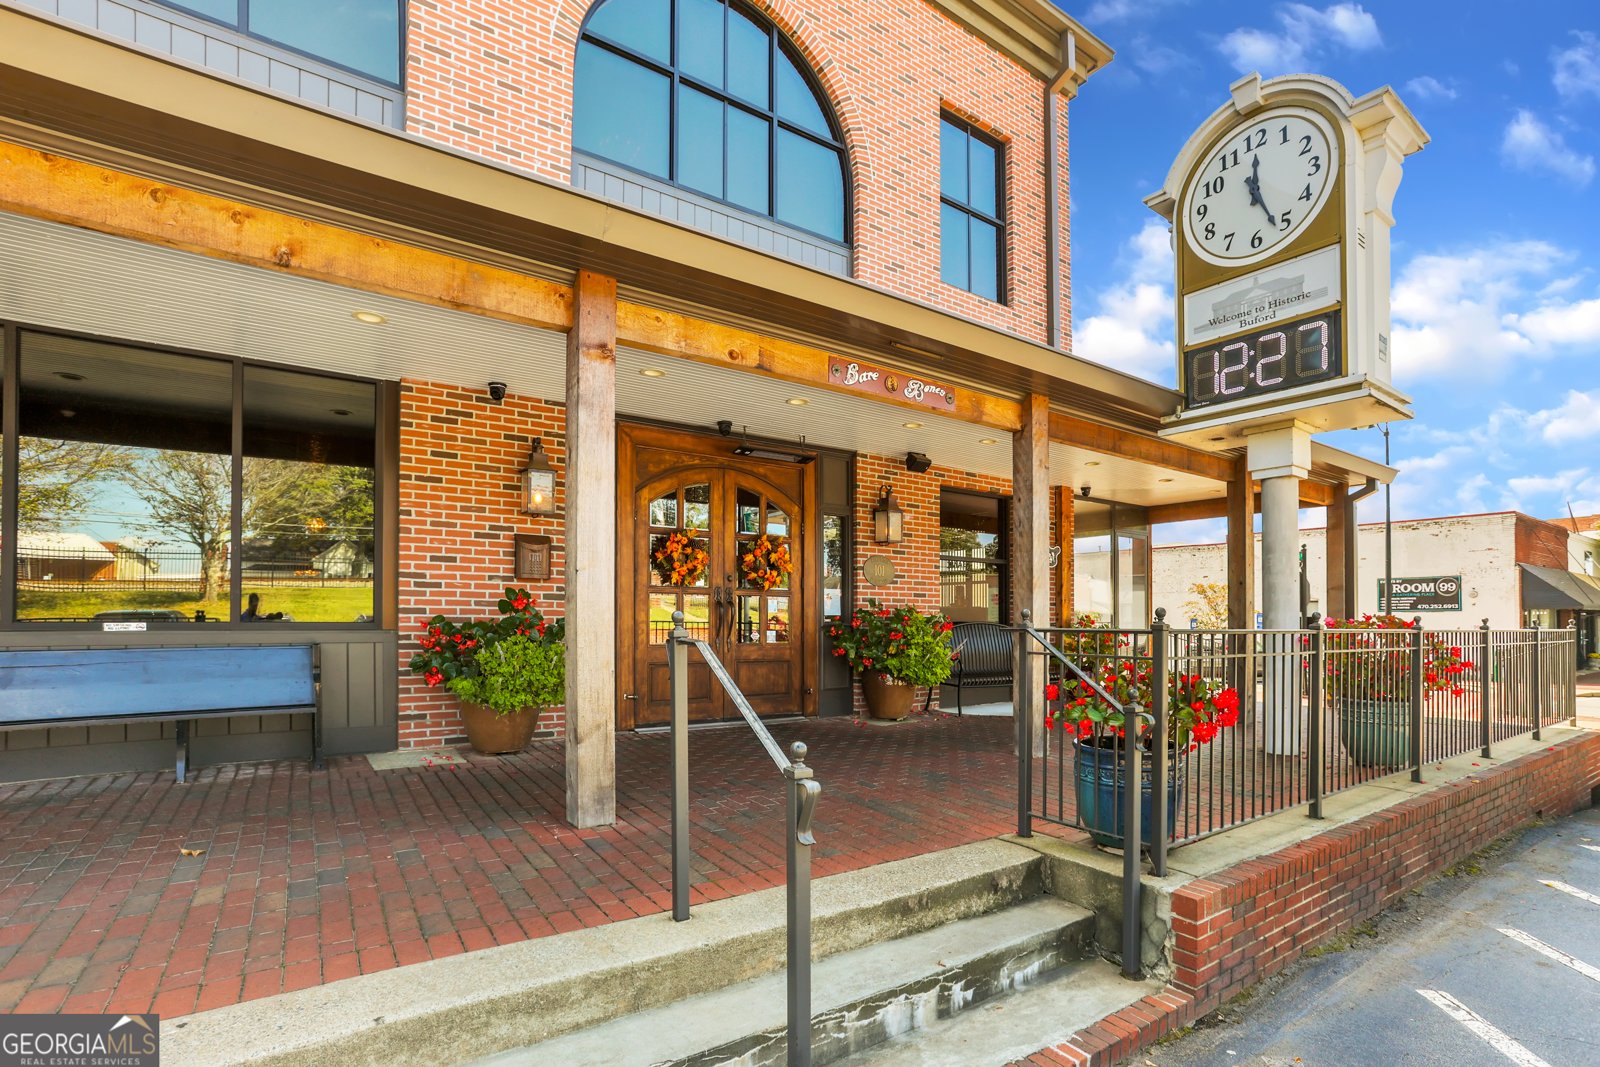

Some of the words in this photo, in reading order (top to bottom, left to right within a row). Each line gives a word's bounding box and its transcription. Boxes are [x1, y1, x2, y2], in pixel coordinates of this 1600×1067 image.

[1243, 127, 1268, 154] 12
[1278, 124, 1290, 145] 1
[1298, 135, 1312, 157] 2
[1218, 148, 1241, 173] 11
[1307, 155, 1321, 177] 3
[1202, 176, 1225, 200] 10
[1297, 182, 1312, 202] 4
[1196, 204, 1208, 222] 9
[1279, 209, 1292, 232] 5
[1204, 222, 1216, 241] 8
[1223, 232, 1235, 252] 7
[1250, 229, 1263, 249] 6
[1208, 309, 1252, 327] Welcome
[1254, 304, 1265, 315] to
[1267, 290, 1311, 310] Historic
[1239, 310, 1277, 329] Buford
[1213, 320, 1329, 395] 12:27
[842, 362, 879, 385] Bare
[904, 379, 946, 402] Bones
[1392, 583, 1435, 593] ROOM
[1439, 582, 1456, 592] 99
